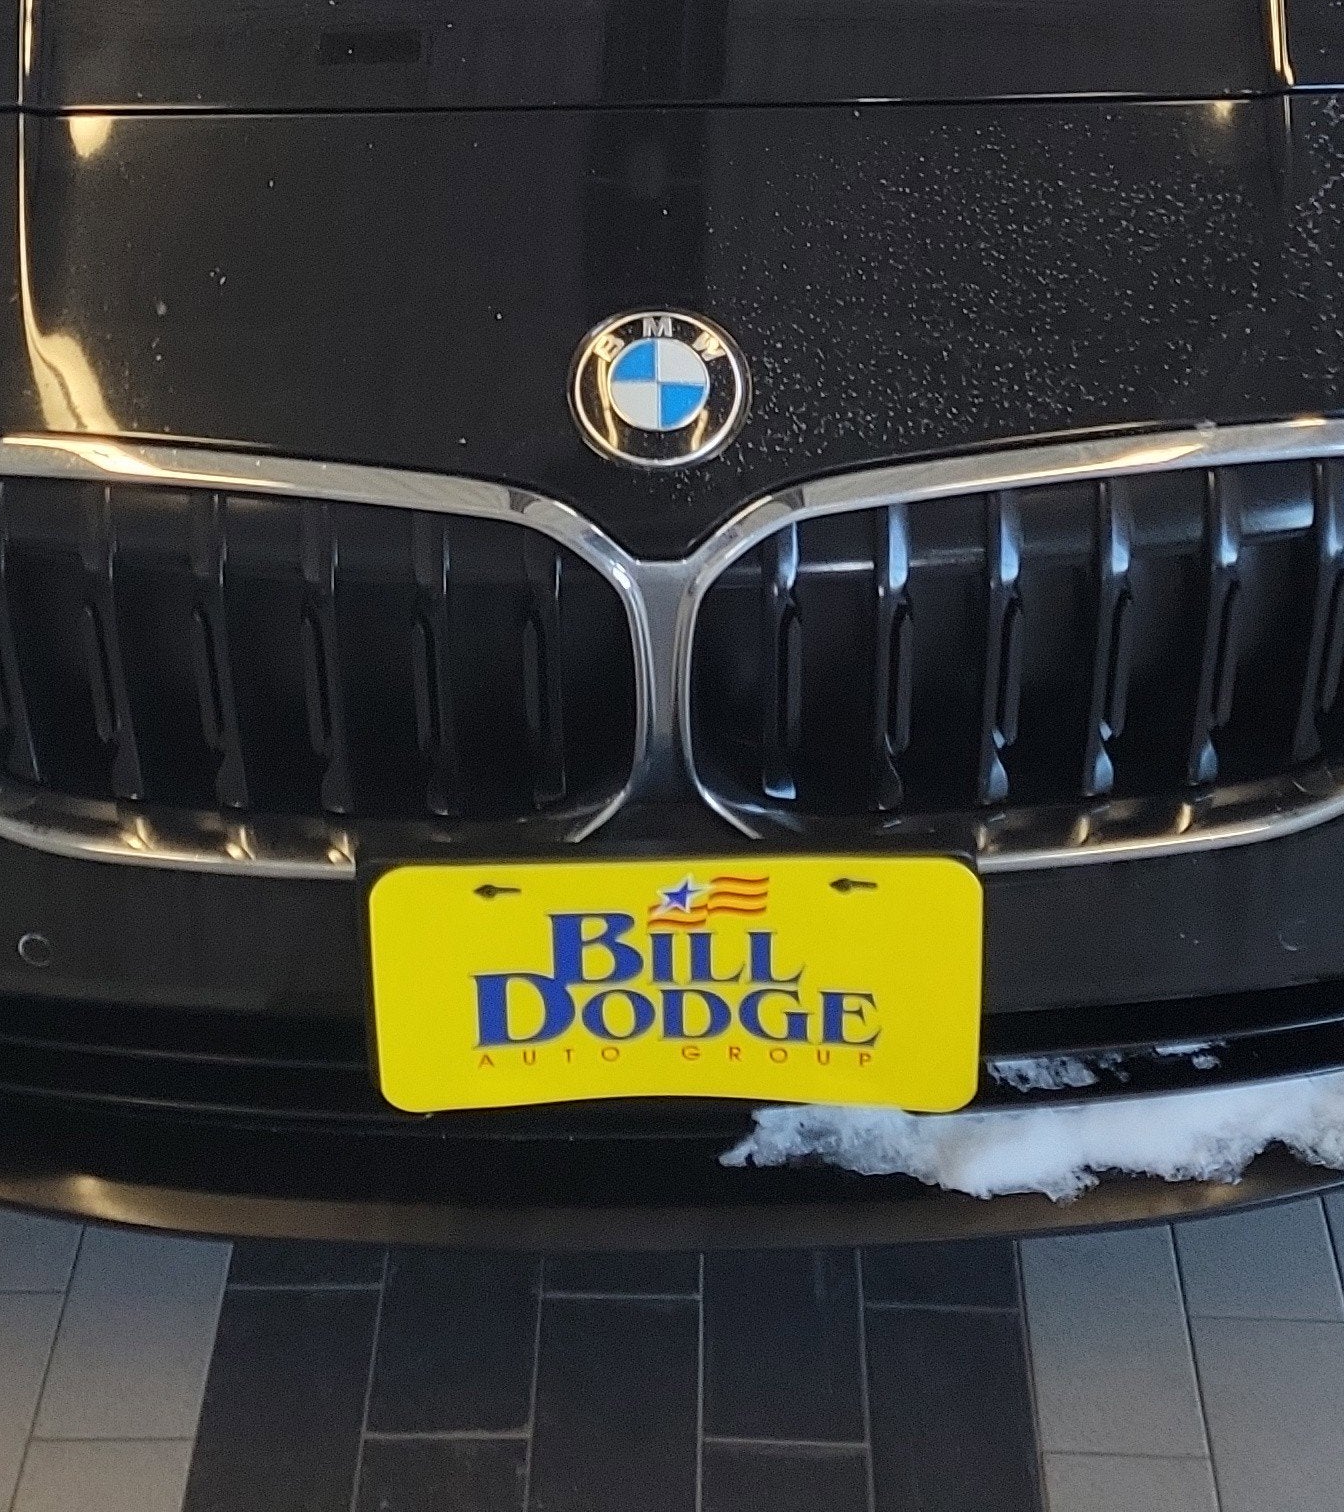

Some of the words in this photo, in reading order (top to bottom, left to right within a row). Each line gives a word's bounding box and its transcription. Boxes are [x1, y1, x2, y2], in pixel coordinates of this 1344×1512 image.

[593, 316, 727, 362] BMW
[548, 911, 807, 986] BILL
[470, 972, 883, 1049] DODGE
[477, 1045, 621, 1070] AUTO
[680, 1044, 873, 1069] GROUP
